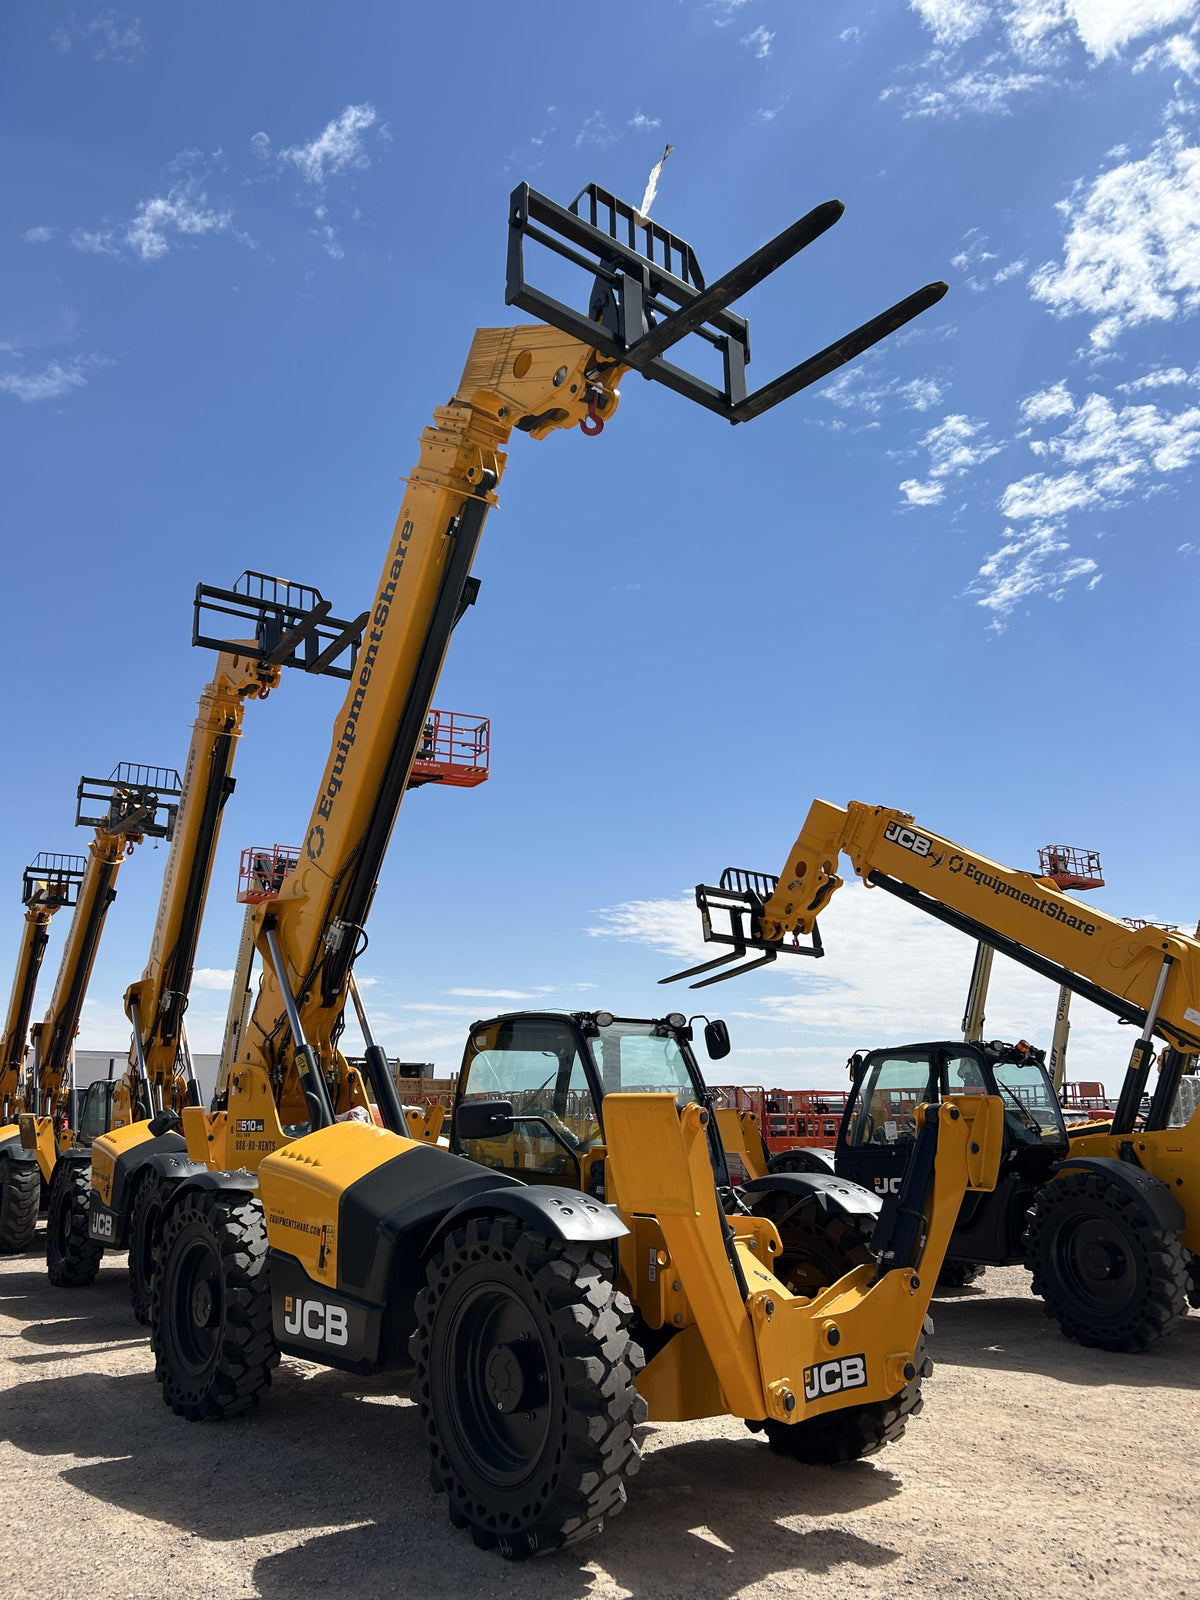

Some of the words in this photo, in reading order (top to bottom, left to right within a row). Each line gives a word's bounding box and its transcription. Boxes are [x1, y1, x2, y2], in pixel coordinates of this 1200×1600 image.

[884, 823, 931, 857] JCB
[235, 1140, 276, 1152] 888-80-RENTS
[874, 1177, 903, 1194] JC
[92, 1212, 113, 1236] JCB
[269, 1213, 321, 1237] EQUIPMENTSHARE.COM
[284, 1297, 348, 1346] JCB
[805, 1357, 866, 1399] JCB
